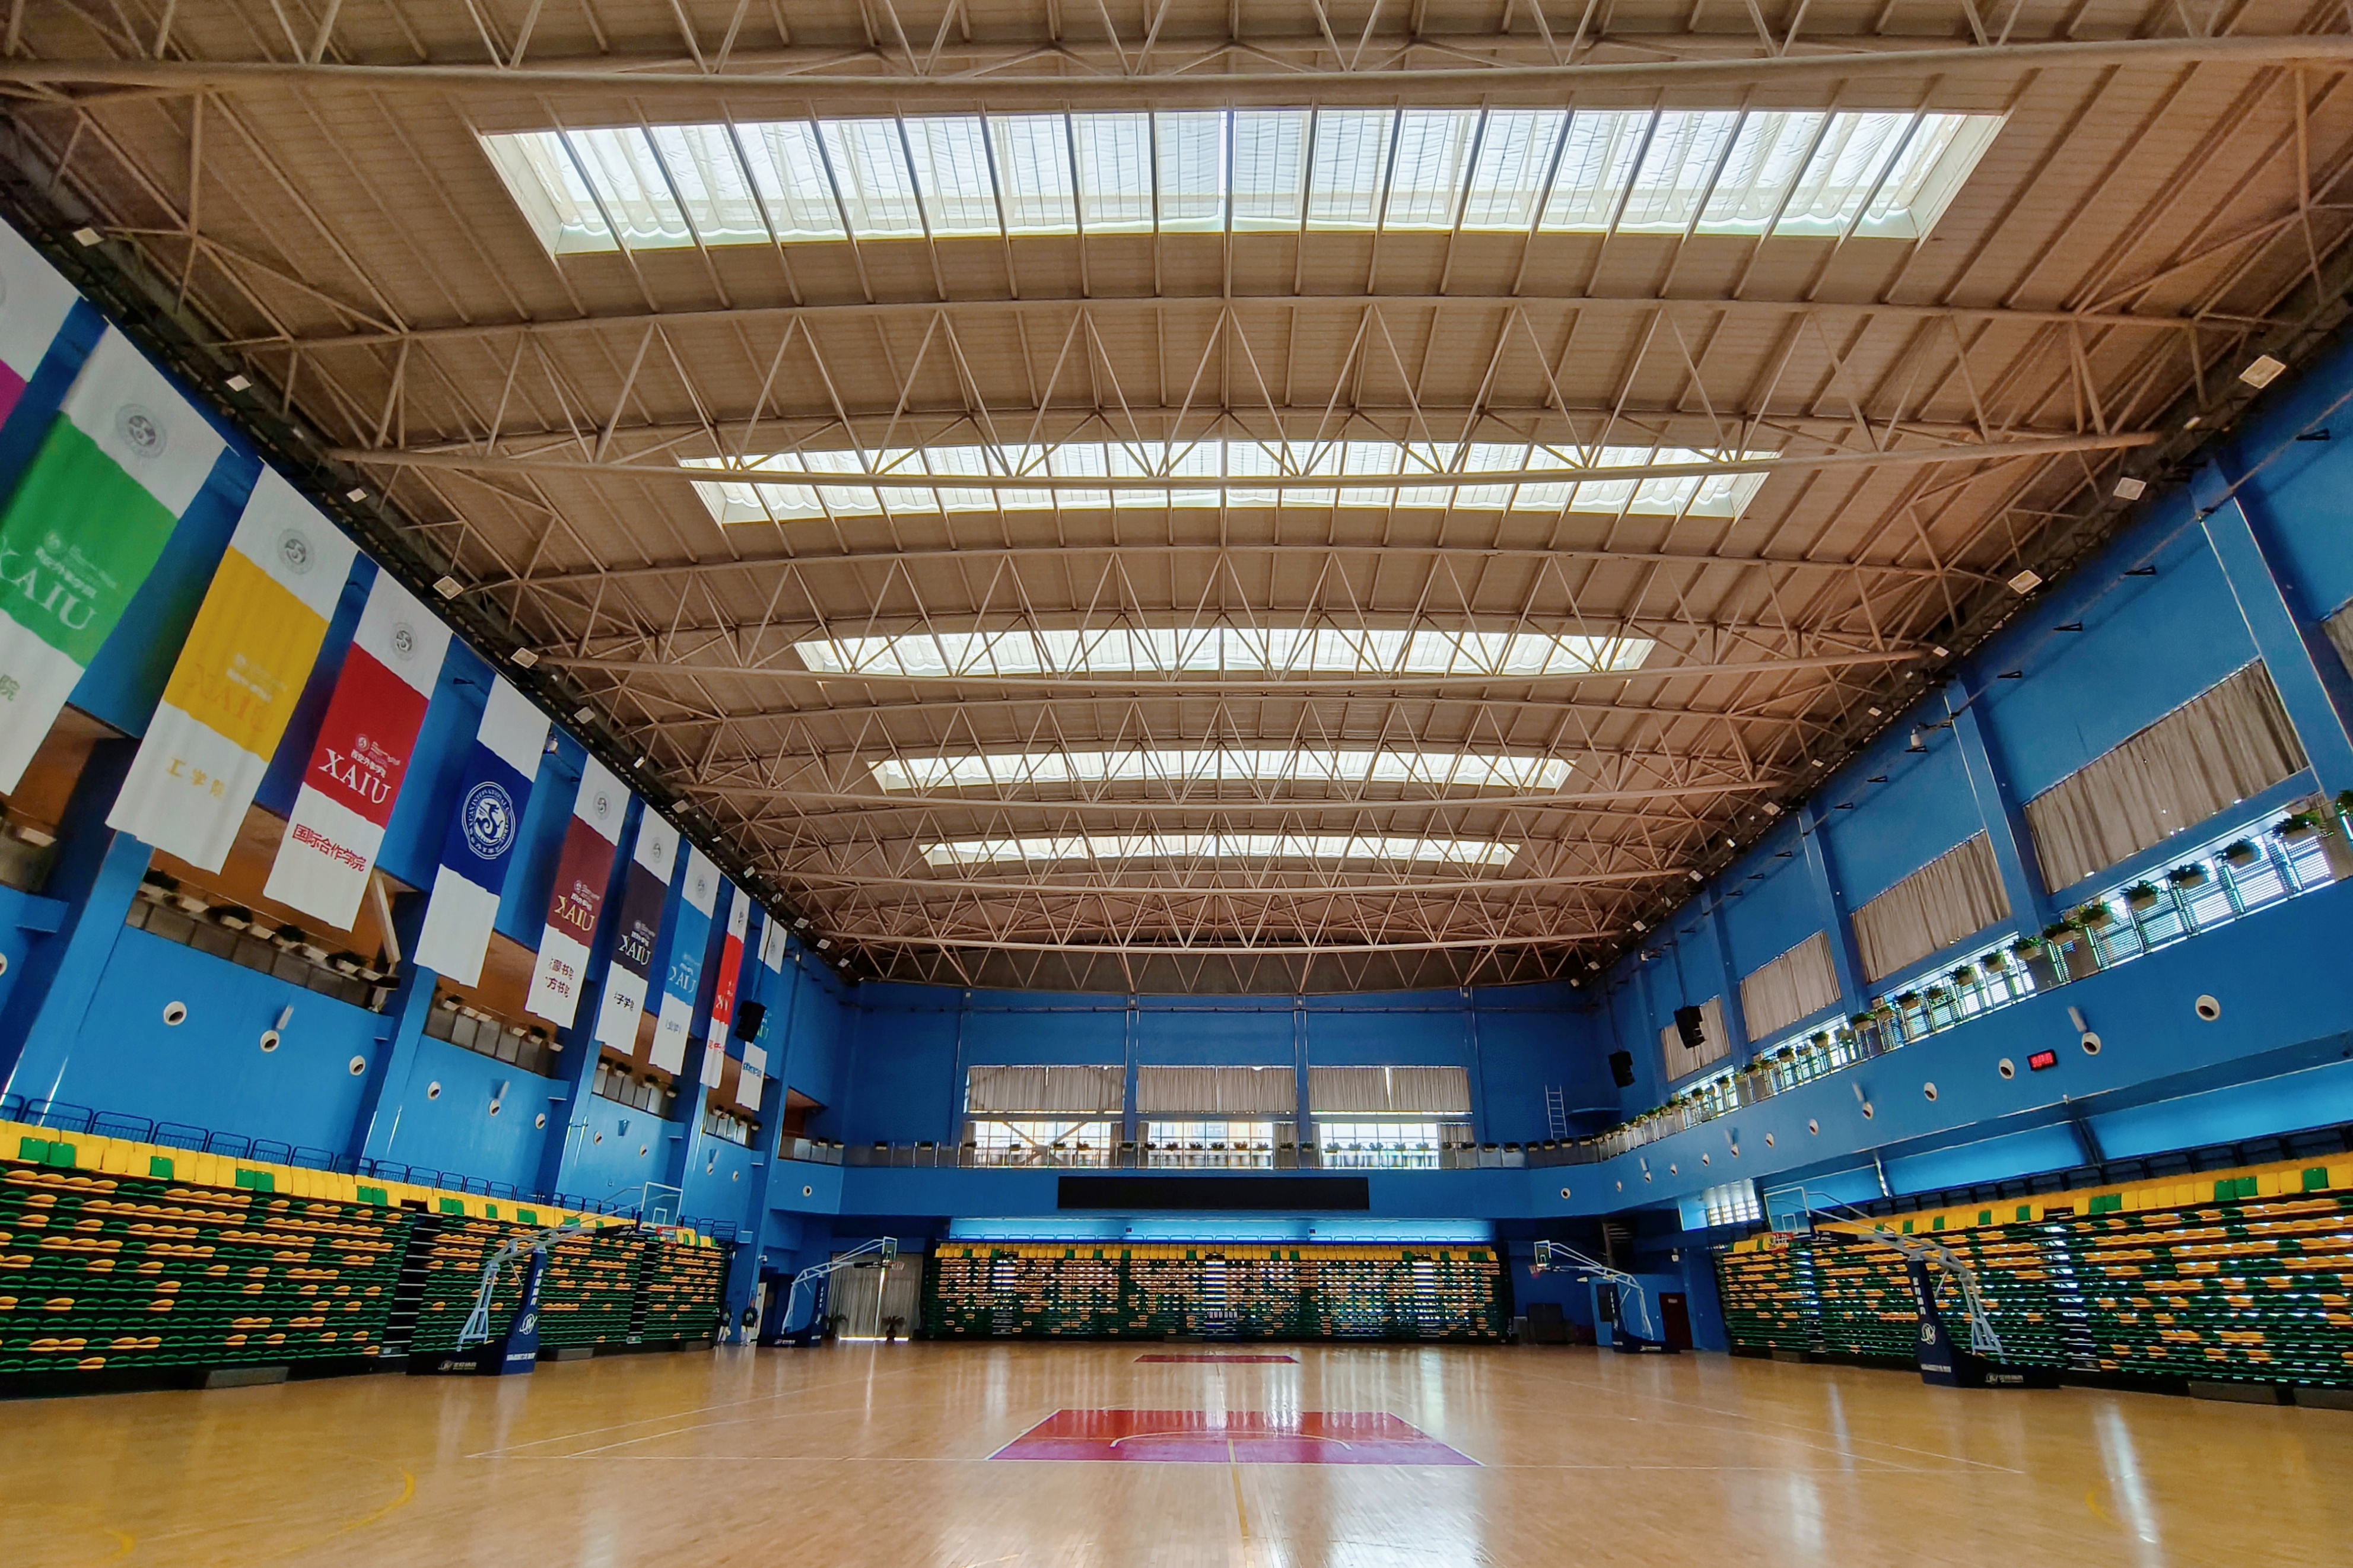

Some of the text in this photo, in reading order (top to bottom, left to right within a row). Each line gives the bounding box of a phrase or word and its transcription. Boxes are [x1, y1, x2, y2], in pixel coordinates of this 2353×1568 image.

[318, 748, 392, 803] XAIU
[292, 823, 367, 872] 国际合作学院
[554, 895, 595, 931] XAIU
[618, 934, 651, 965] XAIU
[545, 976, 570, 998] 方书
[613, 991, 635, 1012] 子学
